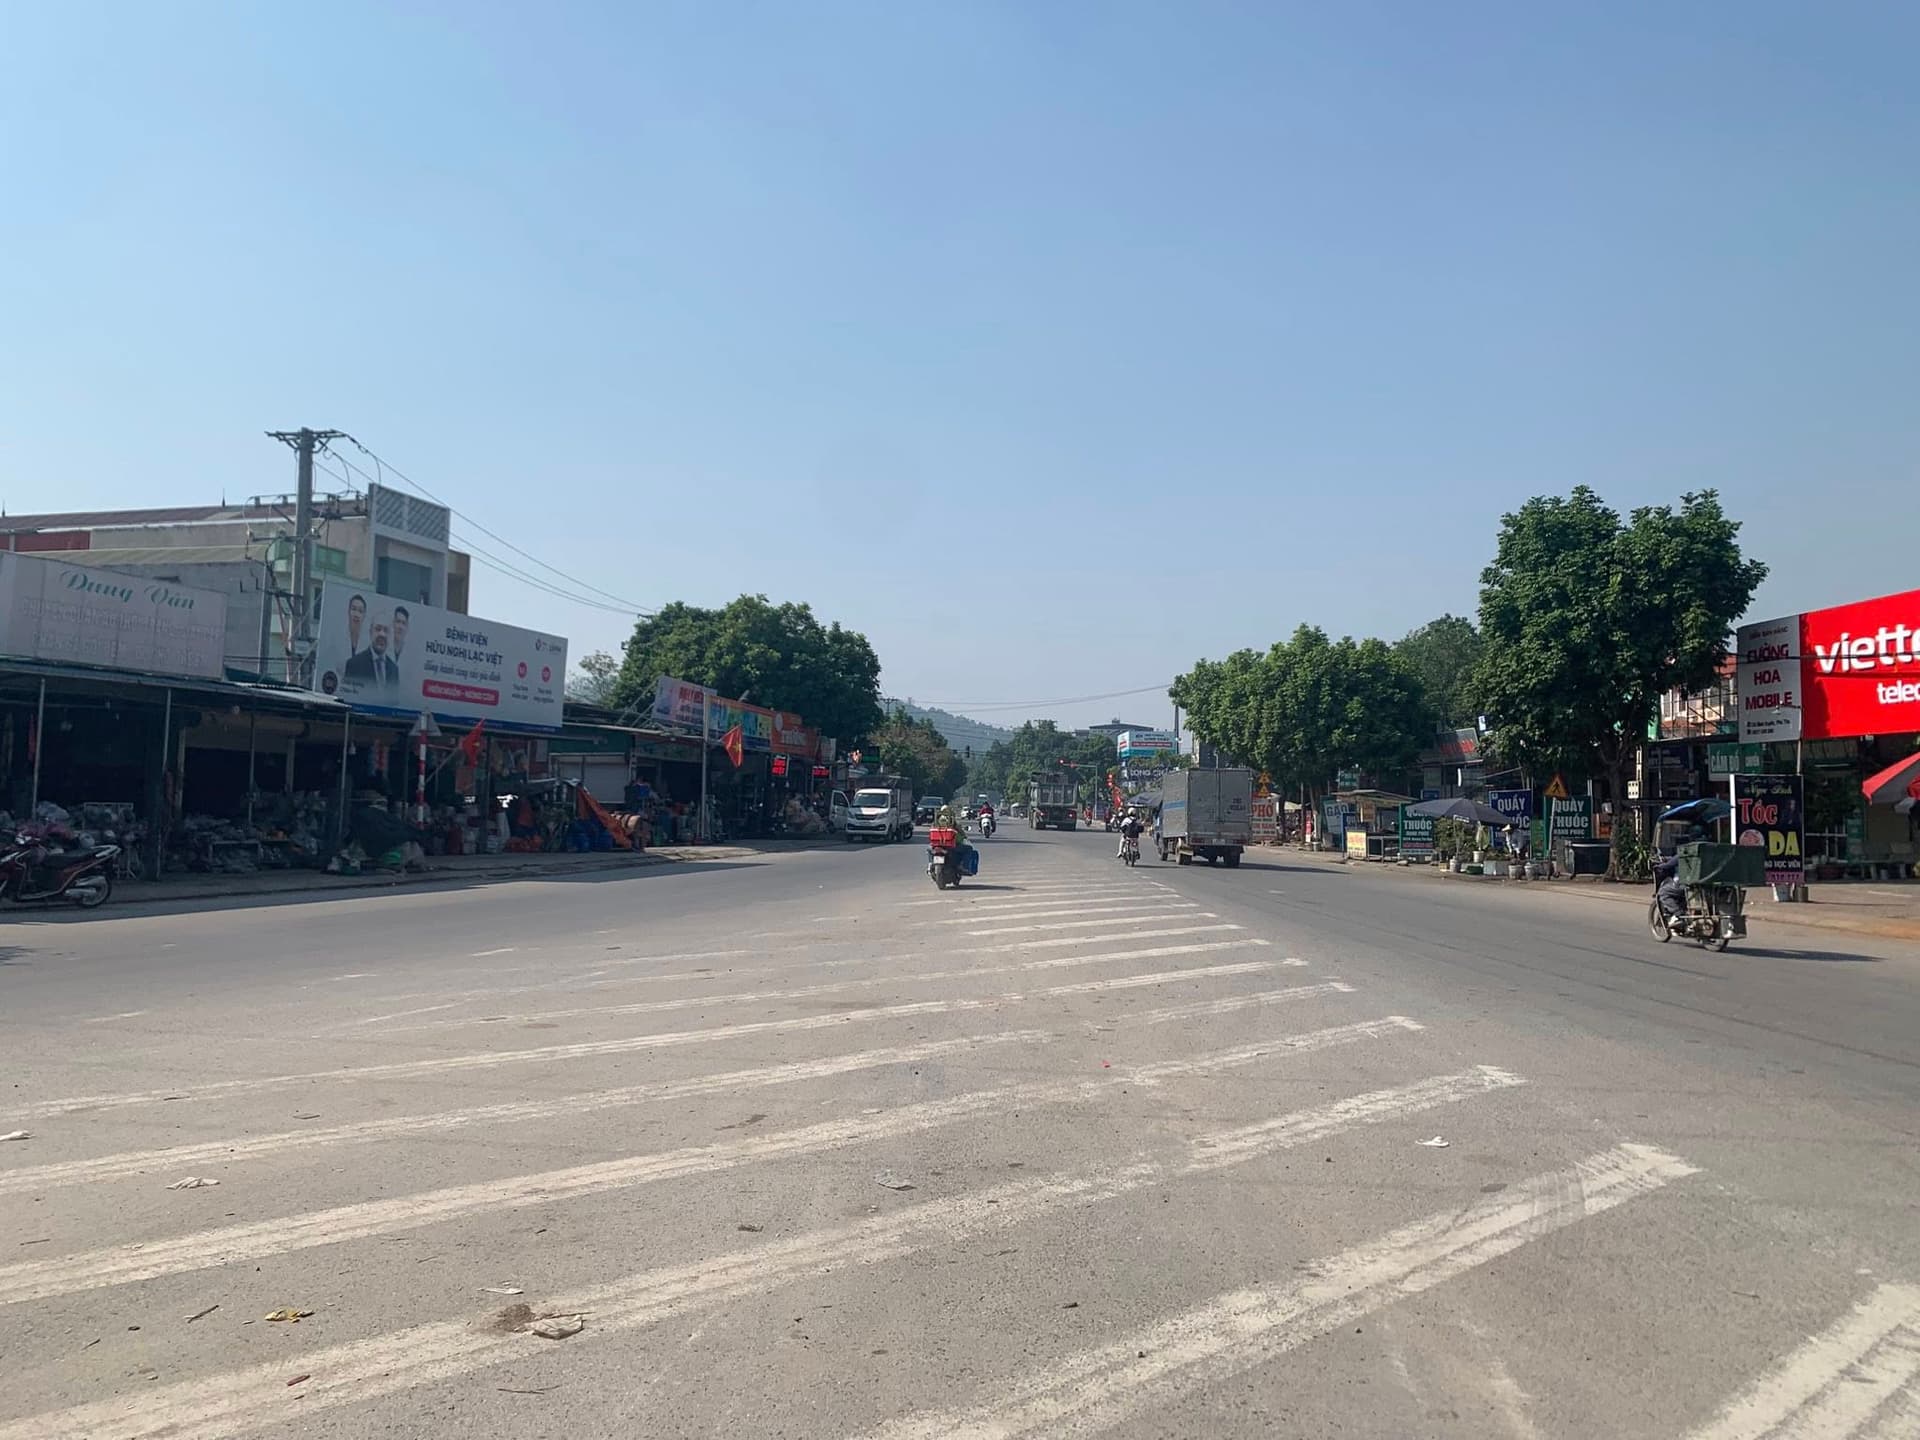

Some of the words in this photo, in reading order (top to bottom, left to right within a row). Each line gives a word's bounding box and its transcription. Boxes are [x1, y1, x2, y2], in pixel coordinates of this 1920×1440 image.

[446, 625, 468, 642] BỆNH
[469, 631, 489, 648] VIỆN
[485, 651, 503, 667] VIỆT
[1753, 669, 1781, 685] HOA
[1745, 692, 1792, 710] MOBILE
[1738, 799, 1778, 824] TÓC
[1768, 831, 1801, 856] DA
